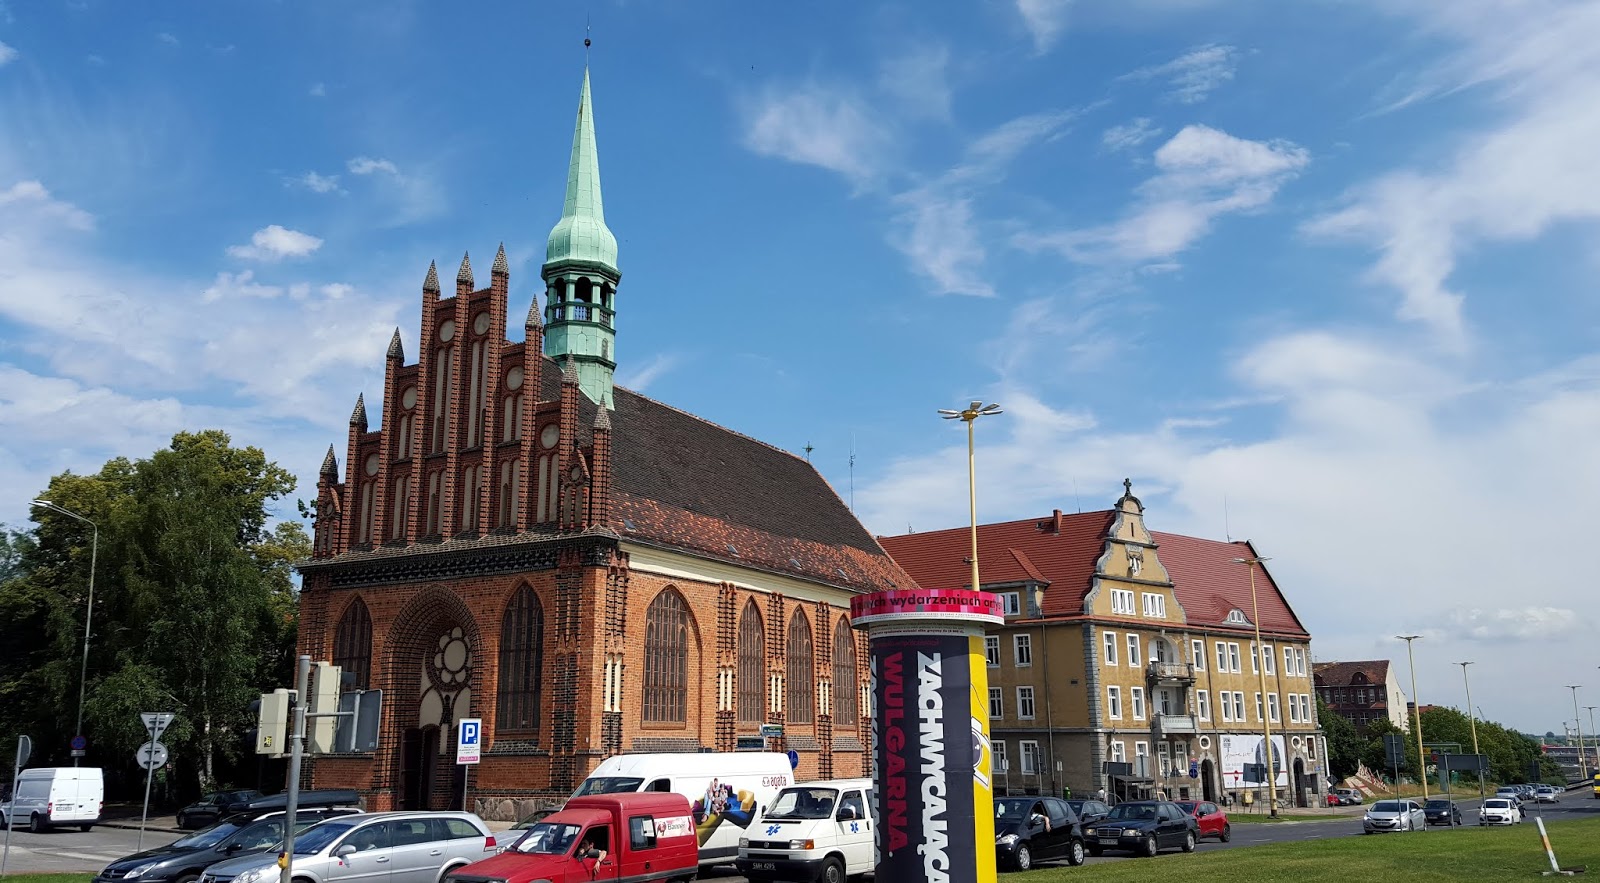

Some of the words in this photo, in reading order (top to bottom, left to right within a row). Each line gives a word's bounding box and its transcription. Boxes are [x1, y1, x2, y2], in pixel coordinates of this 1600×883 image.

[890, 593, 980, 608] wydarzeniach
[465, 724, 476, 742] P
[917, 650, 950, 883] ZACHWYCAJĄCA
[770, 775, 787, 789] agata
